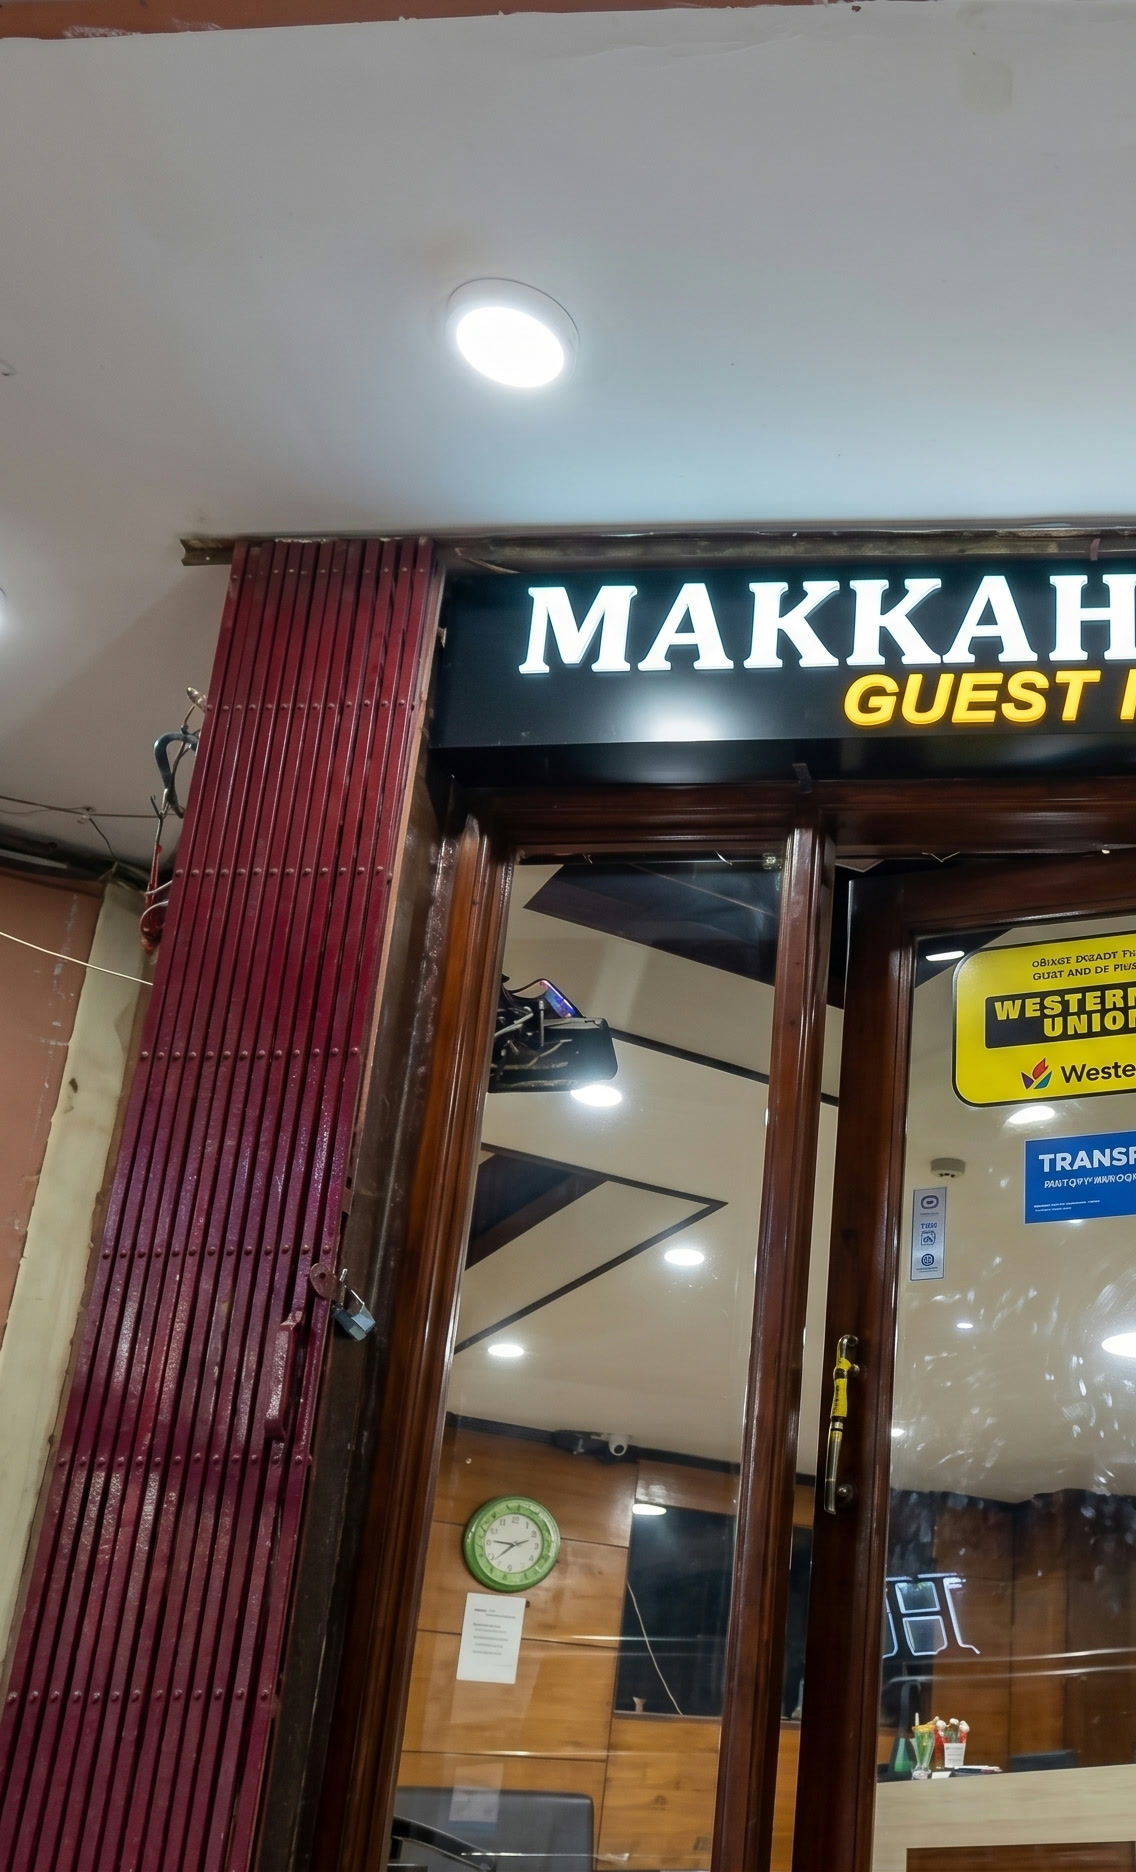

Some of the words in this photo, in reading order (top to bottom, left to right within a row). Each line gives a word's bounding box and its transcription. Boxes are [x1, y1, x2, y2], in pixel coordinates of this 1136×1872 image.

[844, 669, 1101, 727] GUEST
[1067, 967, 1092, 977] AND
[1095, 965, 1110, 974] DE
